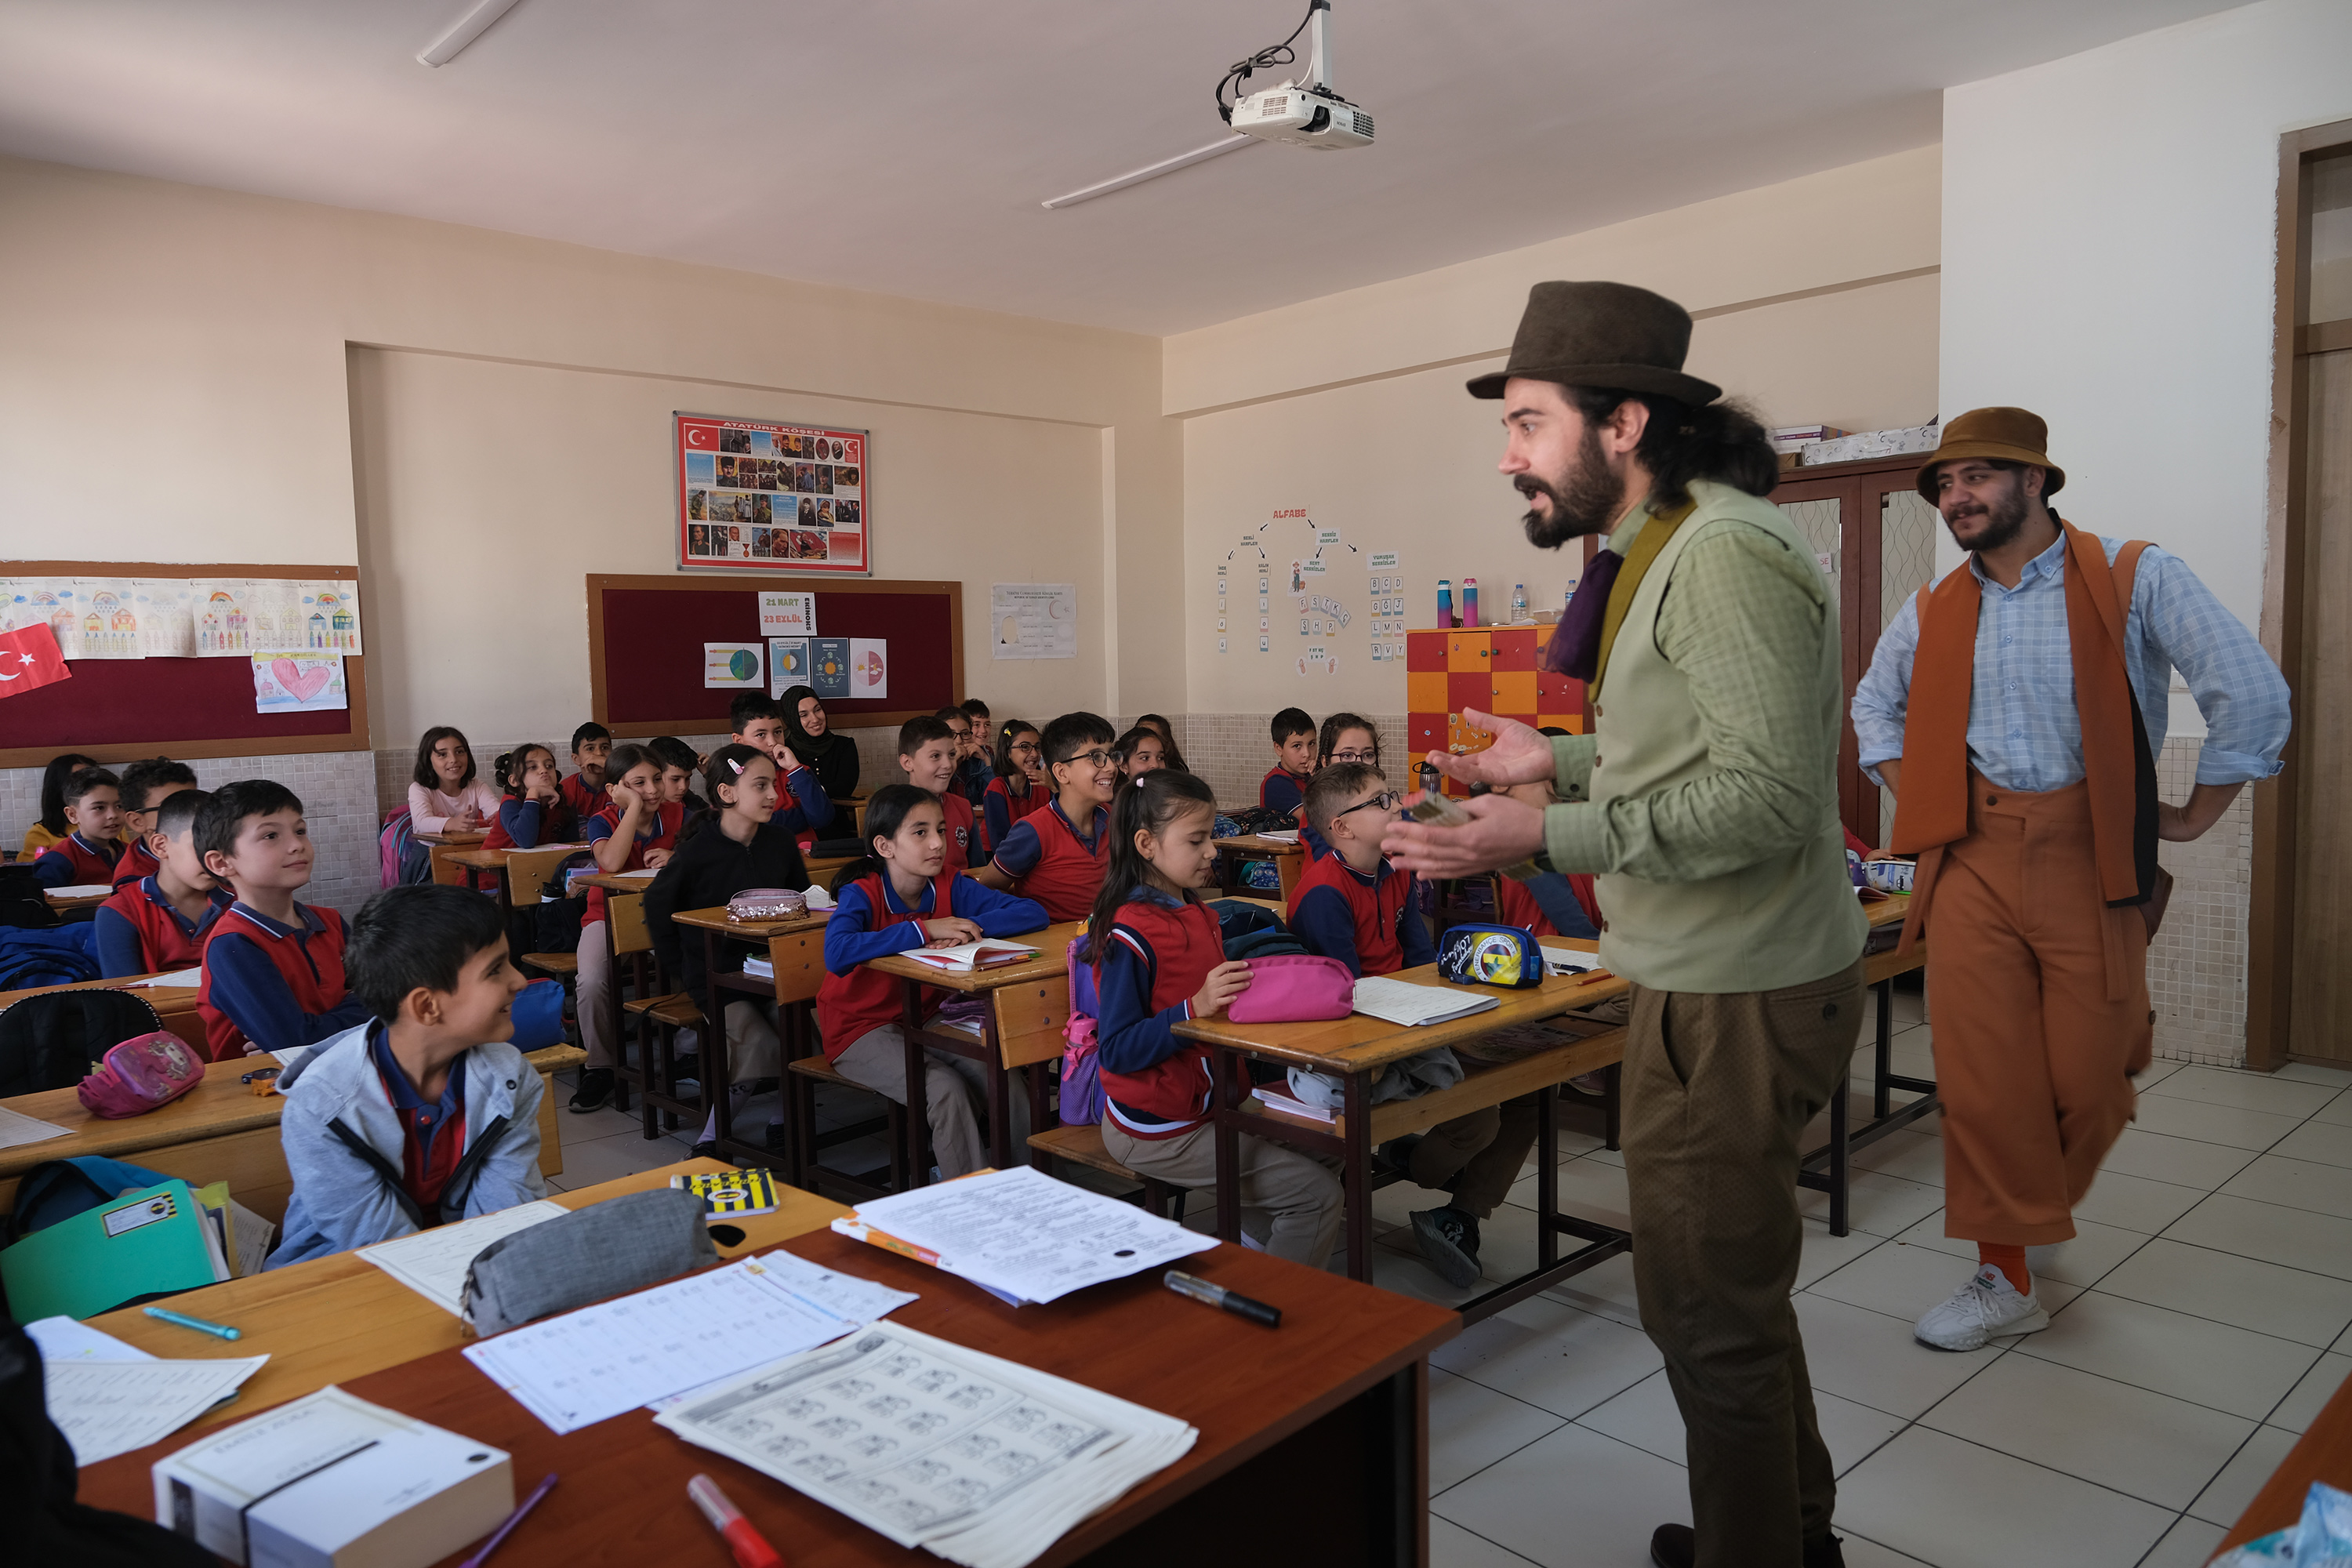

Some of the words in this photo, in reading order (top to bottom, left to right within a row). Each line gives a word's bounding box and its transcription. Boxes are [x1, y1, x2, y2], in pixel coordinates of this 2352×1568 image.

[724, 422, 778, 431] ATATÜRK
[782, 427, 825, 436] KÖŞESİ
[1273, 509, 1306, 518] ALFABE
[775, 614, 803, 623] EYLÜL
[1475, 937, 1497, 975] FENERBAHÇE
[1499, 936, 1514, 950] SPOR
